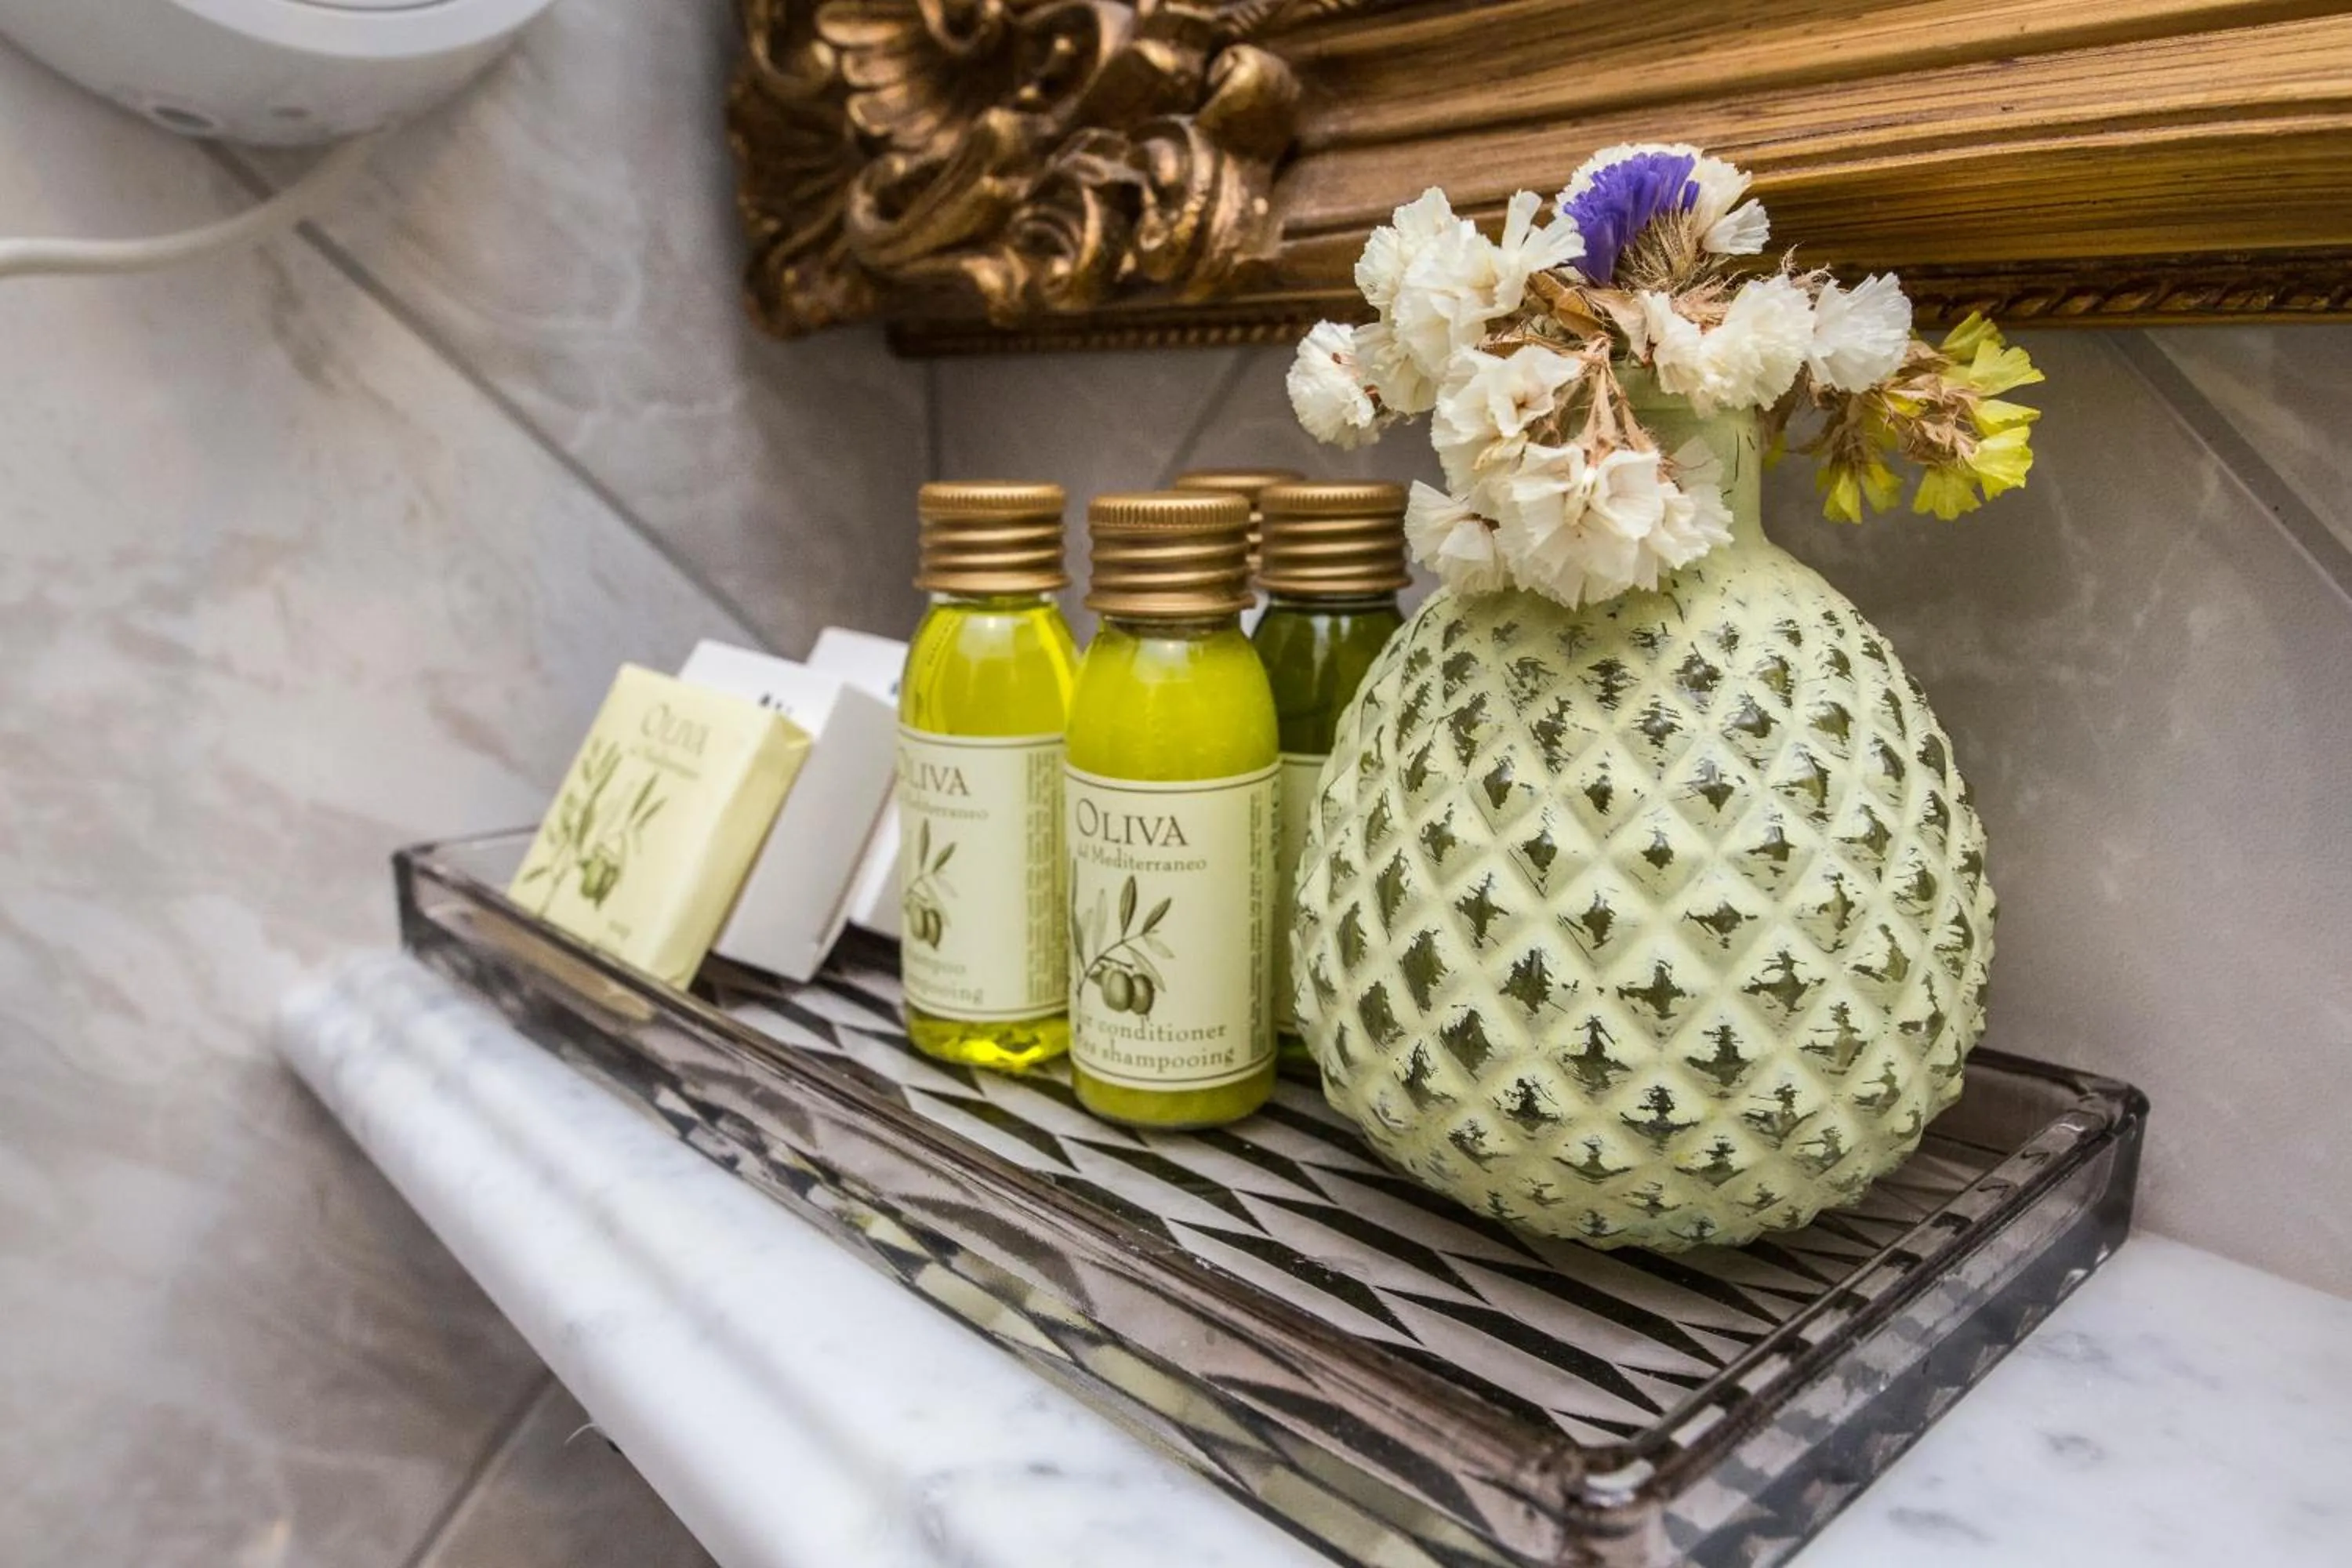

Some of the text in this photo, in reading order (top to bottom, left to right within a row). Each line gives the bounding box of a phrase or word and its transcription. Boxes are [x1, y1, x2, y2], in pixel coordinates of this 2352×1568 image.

[1076, 798, 1189, 848] OLIVA
[1091, 843, 1207, 872] Mediterraneo
[1098, 1014, 1228, 1043] conditioner
[1102, 1036, 1236, 1073] shampooing
